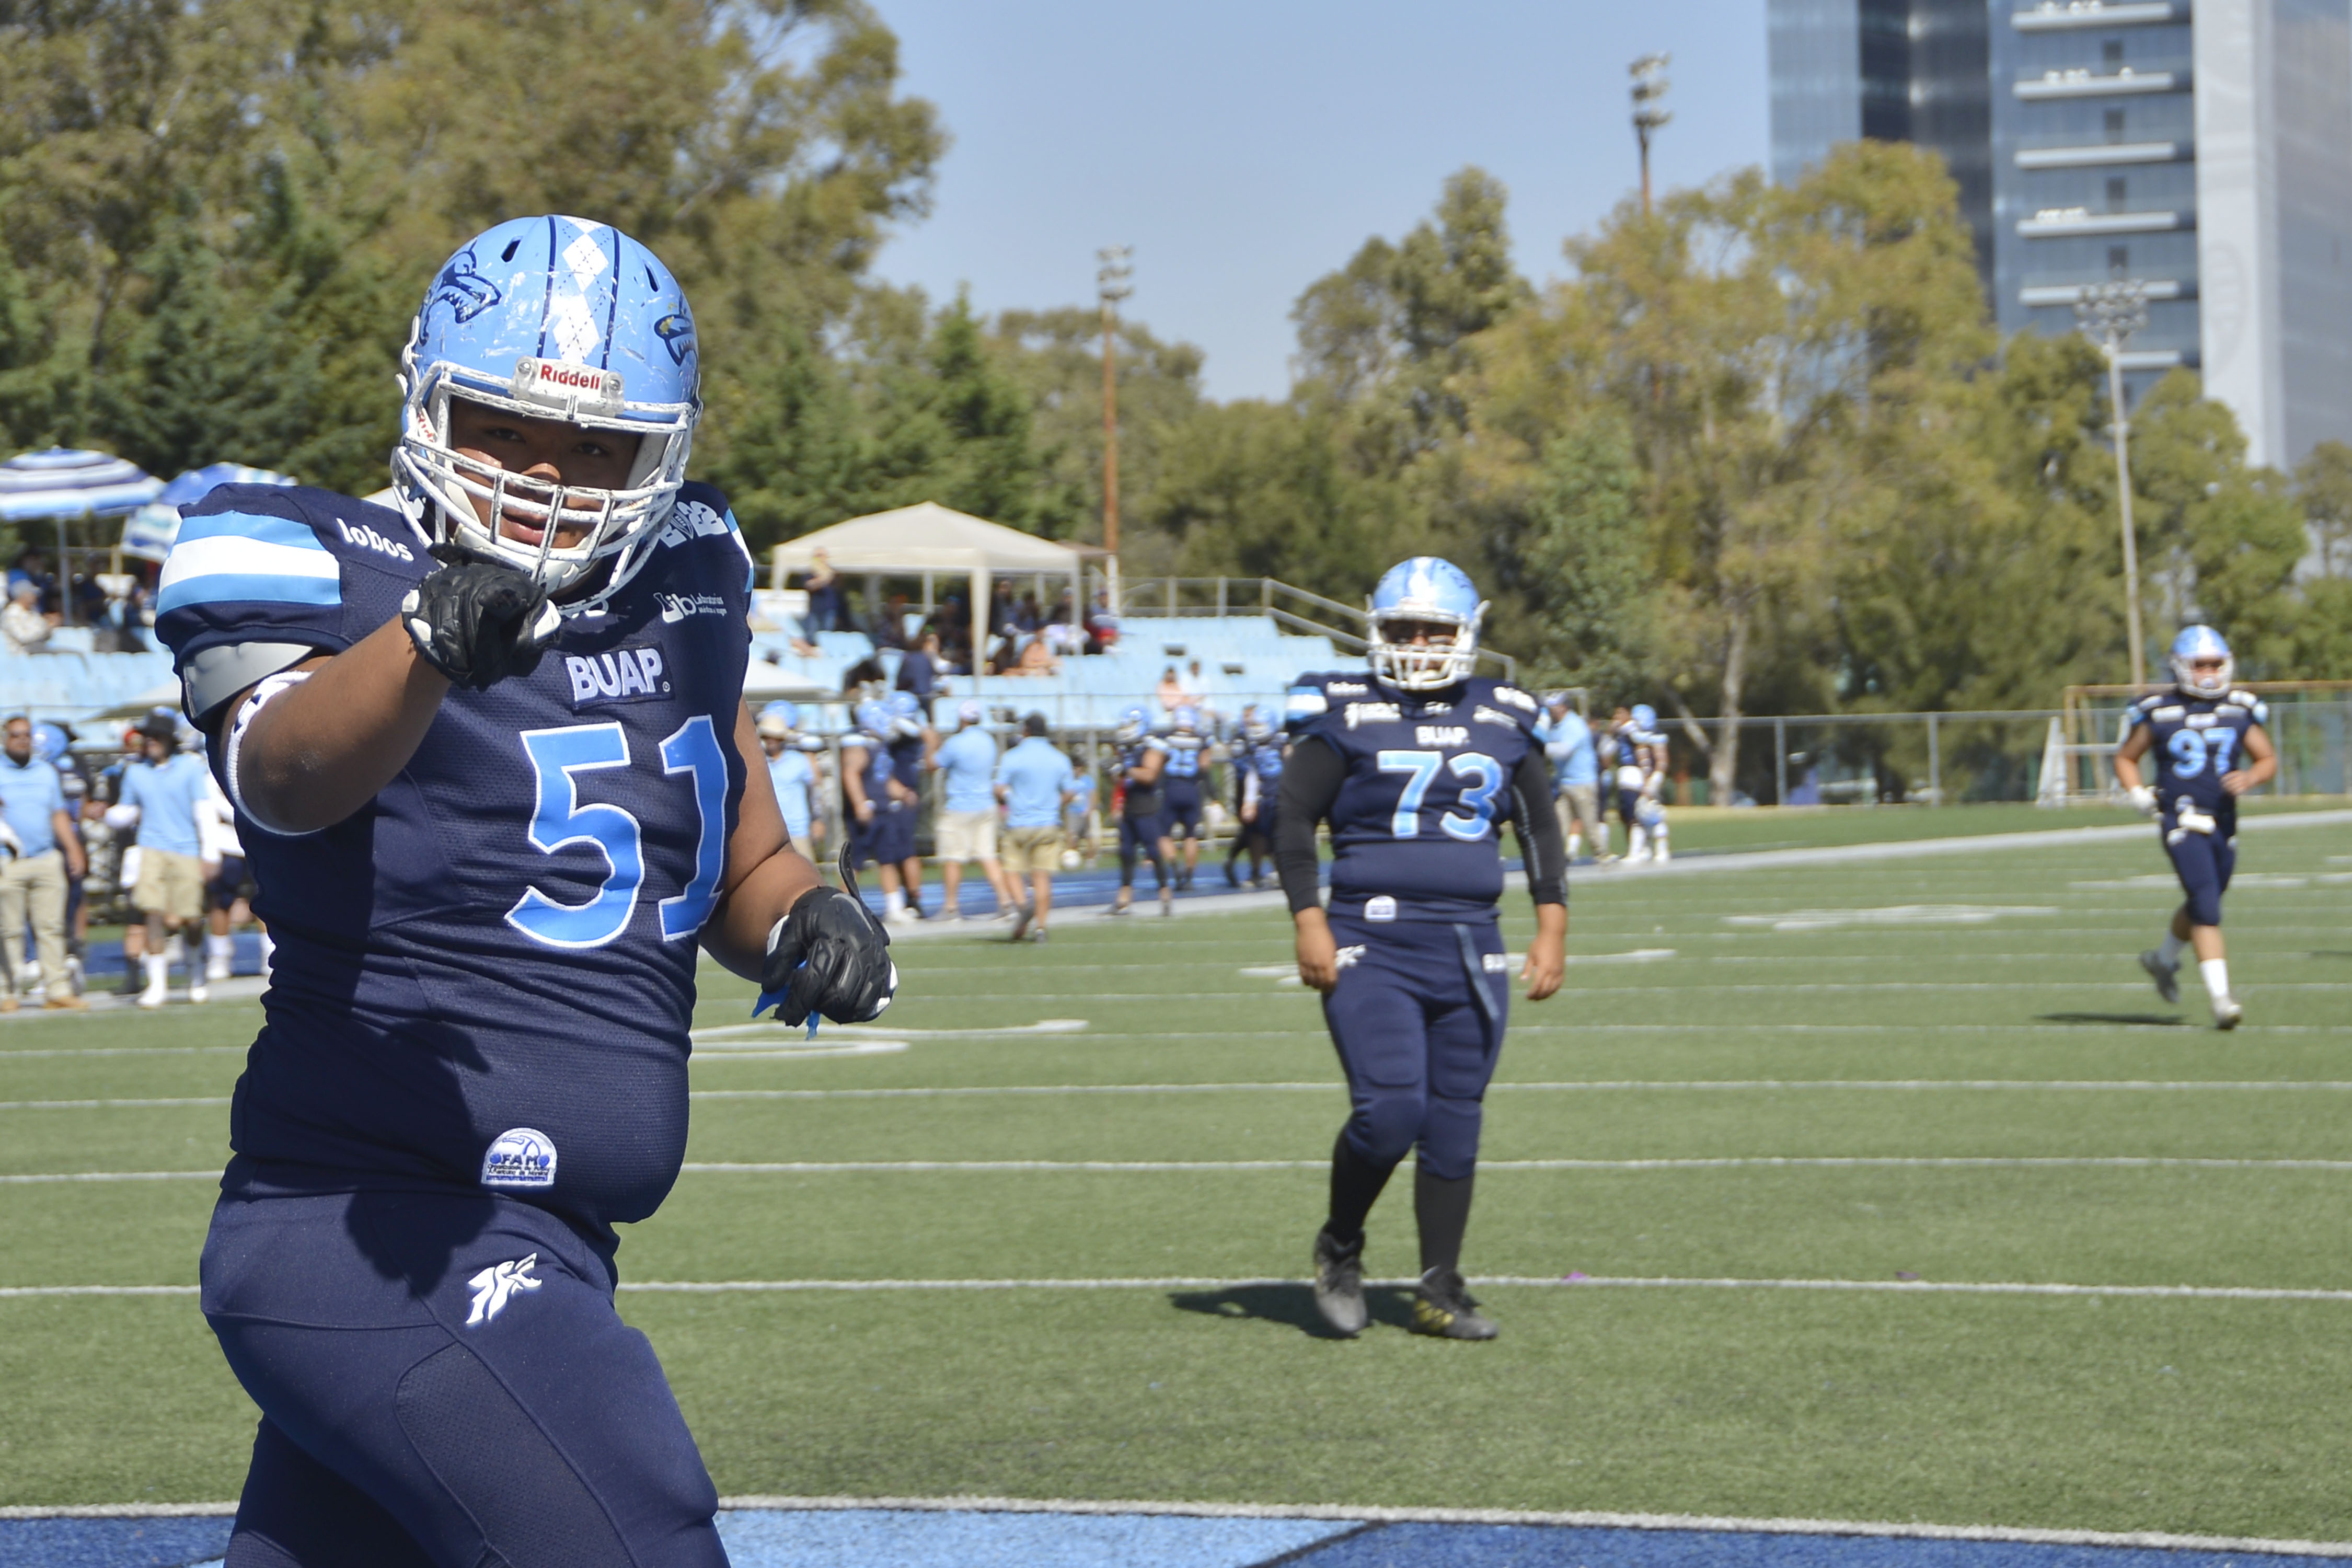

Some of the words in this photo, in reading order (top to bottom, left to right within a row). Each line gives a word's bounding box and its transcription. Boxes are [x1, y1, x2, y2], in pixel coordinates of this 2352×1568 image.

[540, 363, 601, 390] Riddell
[336, 517, 414, 561] lobos
[2167, 727, 2238, 779] 97
[1377, 750, 1504, 842] 73
[503, 714, 729, 948] 51
